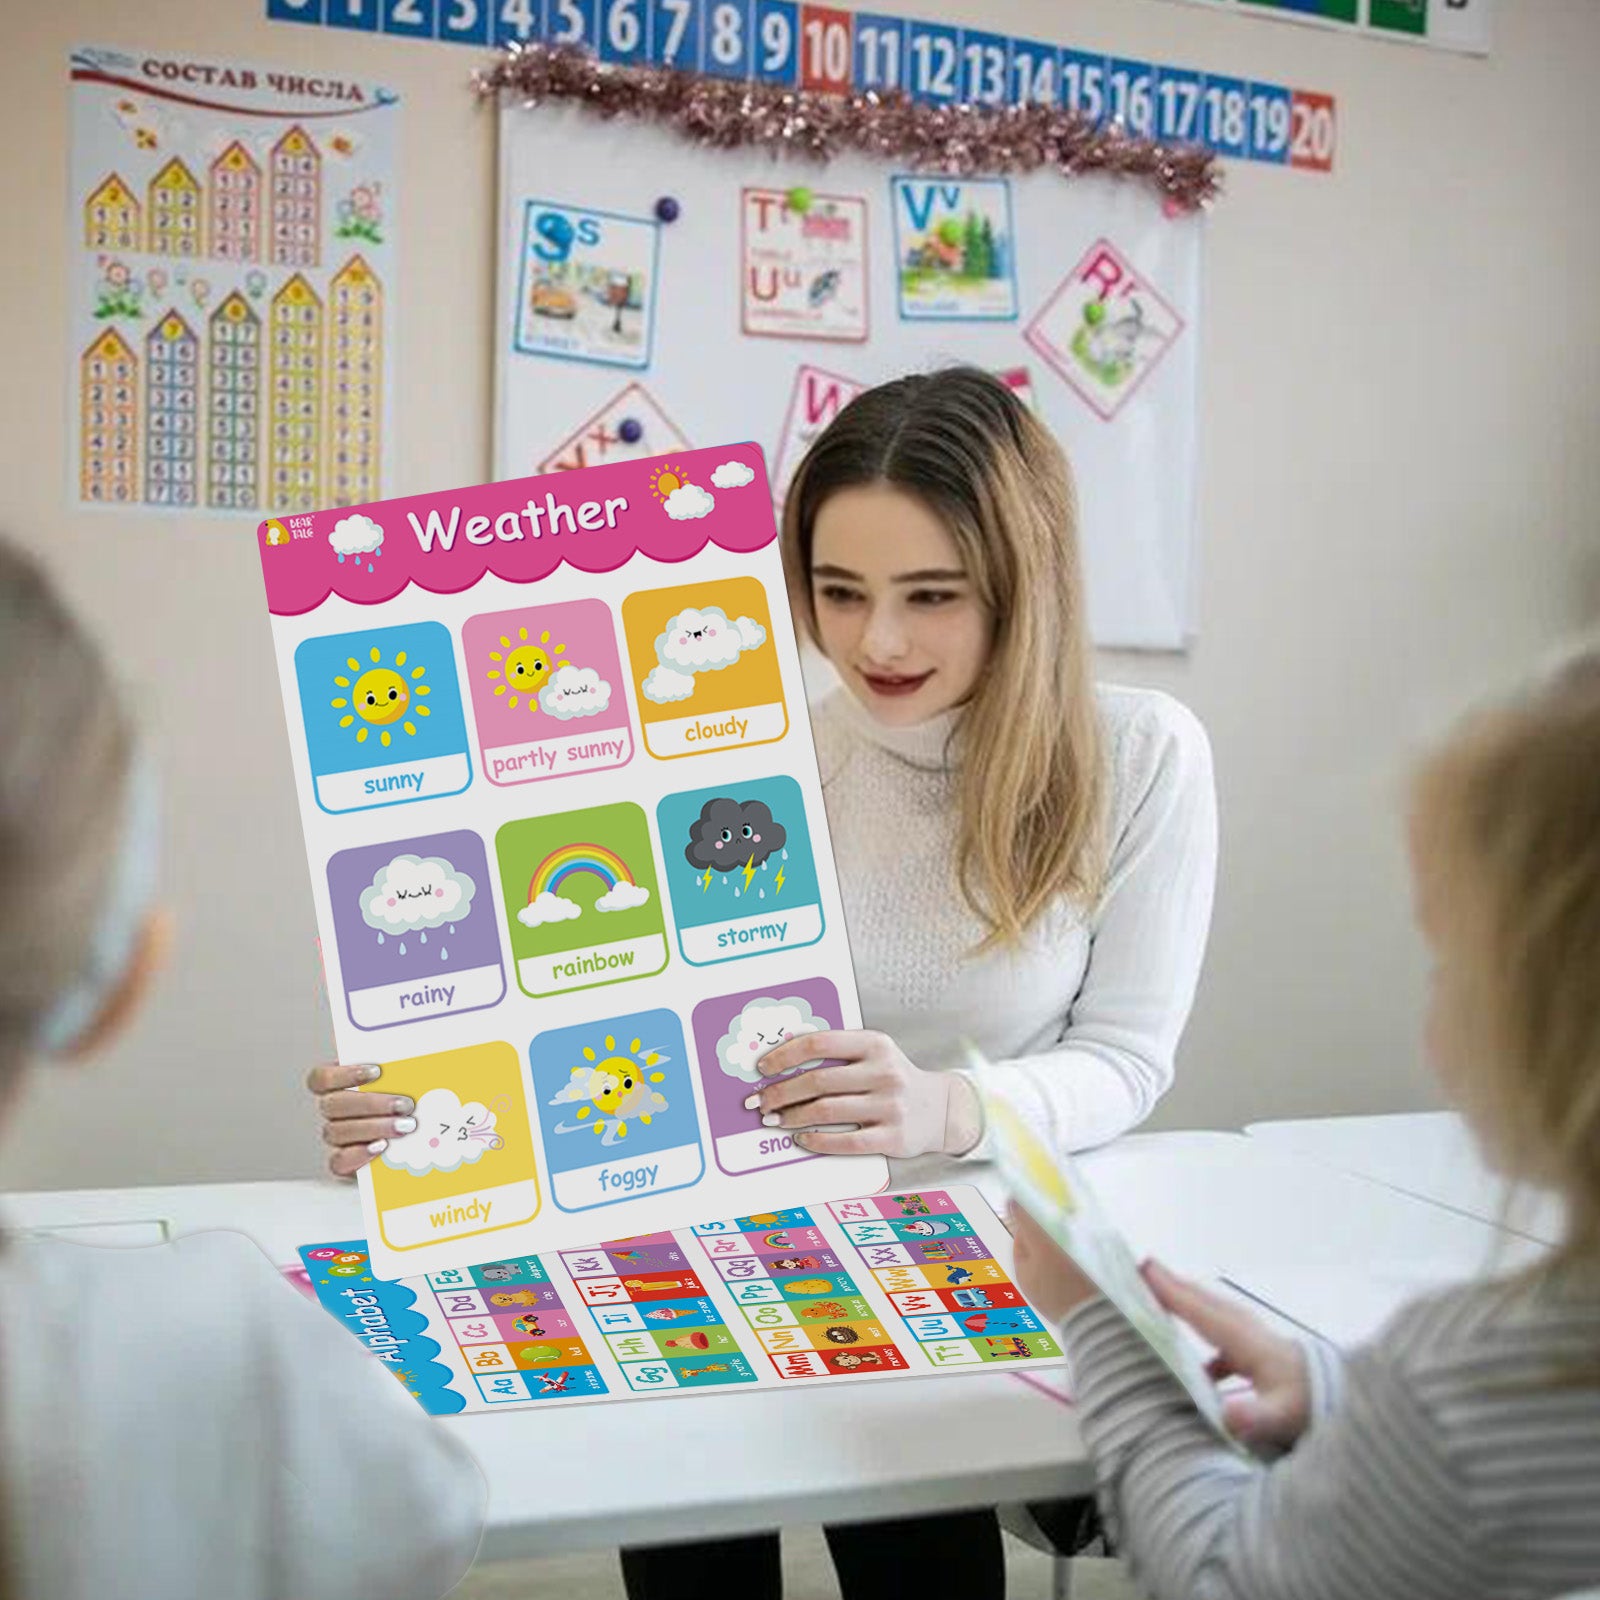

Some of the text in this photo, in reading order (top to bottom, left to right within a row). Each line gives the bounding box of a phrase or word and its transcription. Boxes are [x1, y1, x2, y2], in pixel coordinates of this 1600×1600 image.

[141, 58, 365, 102] СОСТАВ ЧИСЛА
[502, 0, 534, 39] 4
[555, 0, 586, 44] 5
[608, 0, 640, 52] 6
[655, 0, 690, 61] 7
[711, 4, 743, 65] 8
[762, 11, 791, 71] 9
[806, 20, 847, 81] 10
[858, 26, 900, 85] 11
[913, 36, 955, 96] 12
[964, 43, 1005, 101] 13
[1015, 53, 1054, 105] 14
[1062, 63, 1103, 115] 15
[1110, 71, 1151, 130] 16
[1158, 80, 1198, 137] 17
[1205, 87, 1246, 145] 18
[1250, 94, 1289, 152] 19
[1292, 104, 1334, 158] 20
[901, 185, 960, 231] Vv
[532, 213, 600, 263] Ss
[750, 266, 801, 302] Uu
[1081, 252, 1136, 302] Rr
[407, 493, 628, 554] Weather
[684, 715, 749, 744] cloudy
[491, 737, 626, 779] partly sunny
[364, 770, 425, 796] sunny
[716, 921, 789, 950] stormy
[551, 949, 636, 981] rainbow
[399, 983, 457, 1010] rainy
[598, 1164, 660, 1193] foggy
[429, 1198, 494, 1230] windy
[840, 1202, 870, 1219] Zz
[854, 1225, 888, 1242] Yy
[713, 1239, 740, 1253] Rr
[340, 1255, 361, 1263] B
[572, 1256, 604, 1272] Kk
[870, 1247, 901, 1266] Xx
[337, 1266, 357, 1274] A
[435, 1269, 463, 1285] Ee
[727, 1259, 756, 1278] Qq
[885, 1268, 918, 1291] Ww
[587, 1283, 621, 1297] Jj
[740, 1284, 773, 1300] Pp
[444, 1295, 477, 1312] Dd
[902, 1295, 932, 1312] Vv
[340, 1287, 410, 1362] Alphabet
[602, 1313, 632, 1325] Ii
[754, 1307, 783, 1324] Oo
[462, 1323, 489, 1339] Cc
[918, 1318, 949, 1337] Uu
[616, 1337, 649, 1356] Hh
[768, 1330, 800, 1349] Nn
[473, 1351, 504, 1367] Bb
[934, 1345, 965, 1362] Tt
[784, 1353, 817, 1375] Mm
[635, 1366, 669, 1383] Gg
[490, 1378, 518, 1395] Aa
